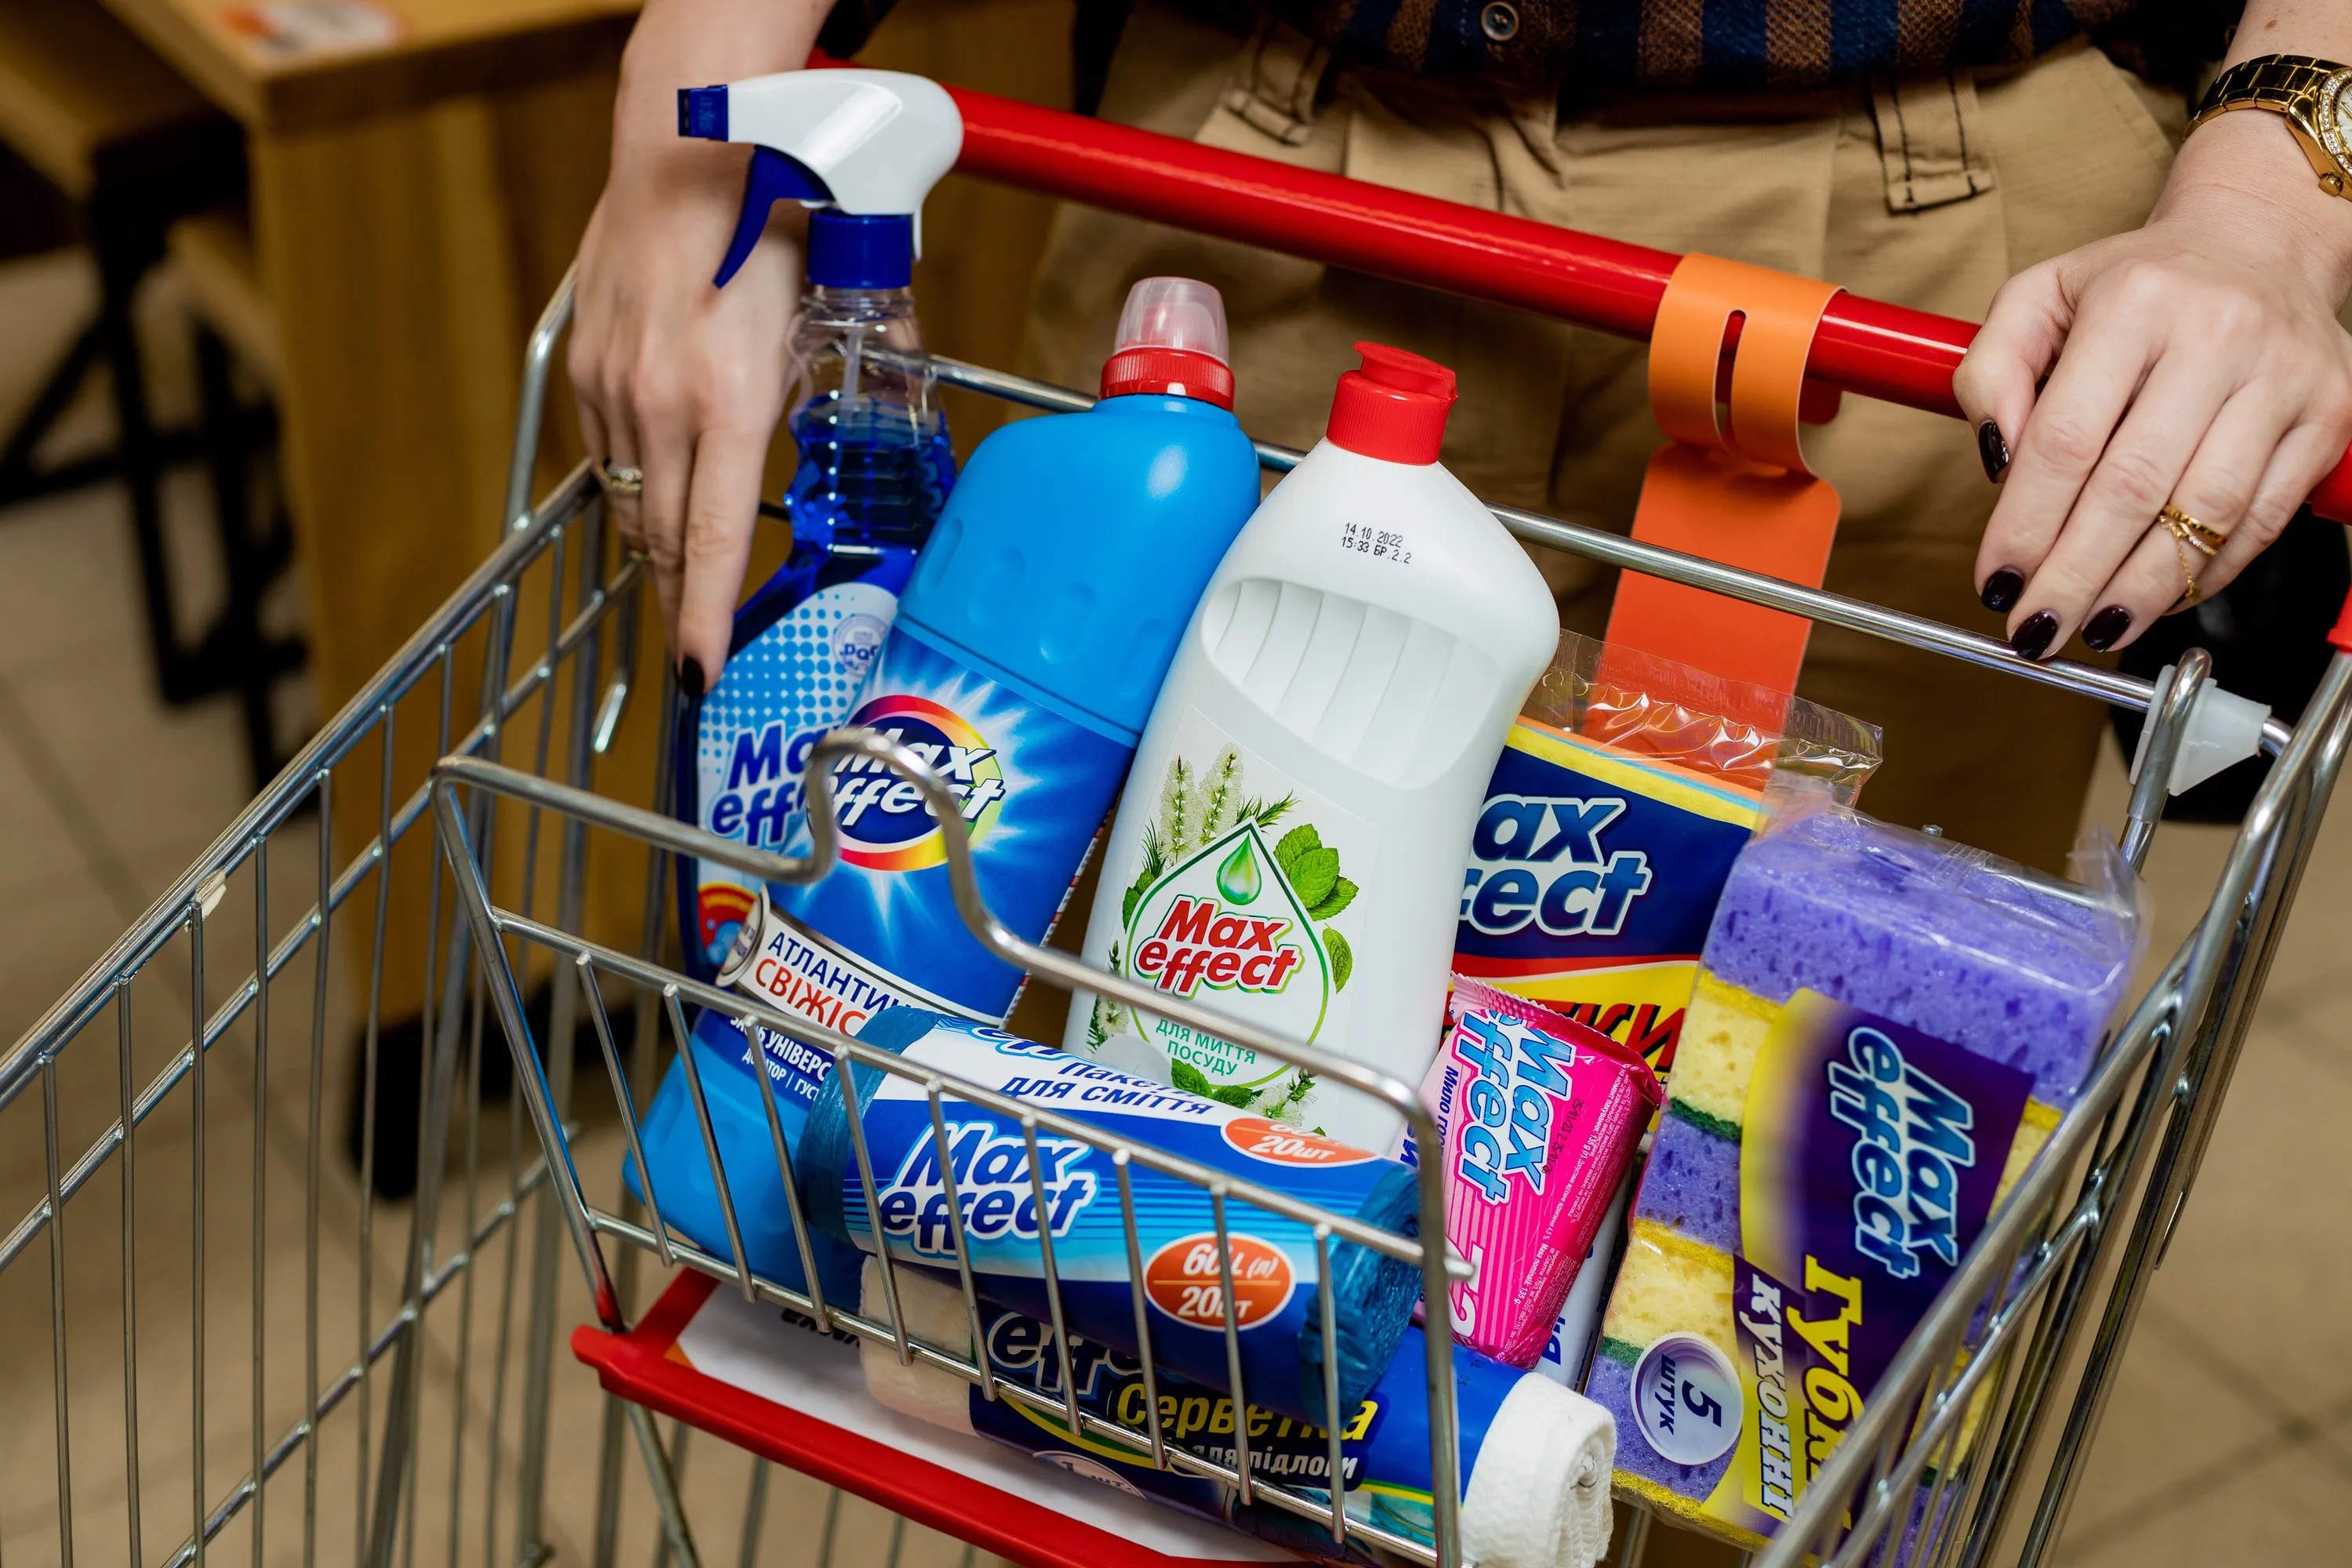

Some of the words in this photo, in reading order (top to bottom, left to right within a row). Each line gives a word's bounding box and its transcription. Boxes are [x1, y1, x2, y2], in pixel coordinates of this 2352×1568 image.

[557, 536, 585, 553] 15:33
[561, 522, 619, 548] 14.10.2022
[727, 721, 823, 789] Ma
[712, 781, 807, 847] eff
[823, 778, 1005, 827] ffect
[1472, 795, 1623, 864] ax
[1156, 898, 1287, 953] Max
[768, 931, 913, 1012] АТЛАНТИ
[1136, 939, 1299, 995] effect
[755, 958, 869, 1038] СВІЖІС
[764, 1030, 833, 1082] УНІВЕРС
[1156, 1018, 1192, 1044] ДЛЯ
[1195, 1031, 1257, 1065] МИТТЯ
[1167, 1040, 1240, 1076] ПОСУДУ
[1439, 1065, 1460, 1115] Мило
[1458, 1008, 1523, 1201] effect
[1504, 1025, 1575, 1193] Max
[898, 1127, 1085, 1189] Max
[1586, 1133, 1597, 1145] 135
[1828, 1027, 1919, 1278] effect
[1905, 1062, 1976, 1266] Max
[878, 1179, 1091, 1251] effect
[1534, 1242, 1548, 1259] Masa
[1516, 1286, 1528, 1300] 135
[1786, 1254, 1864, 1484] Губ
[1116, 1383, 1378, 1441] Сервеа
[1682, 1380, 1722, 1428] 5
[1249, 1446, 1359, 1479] підлои
